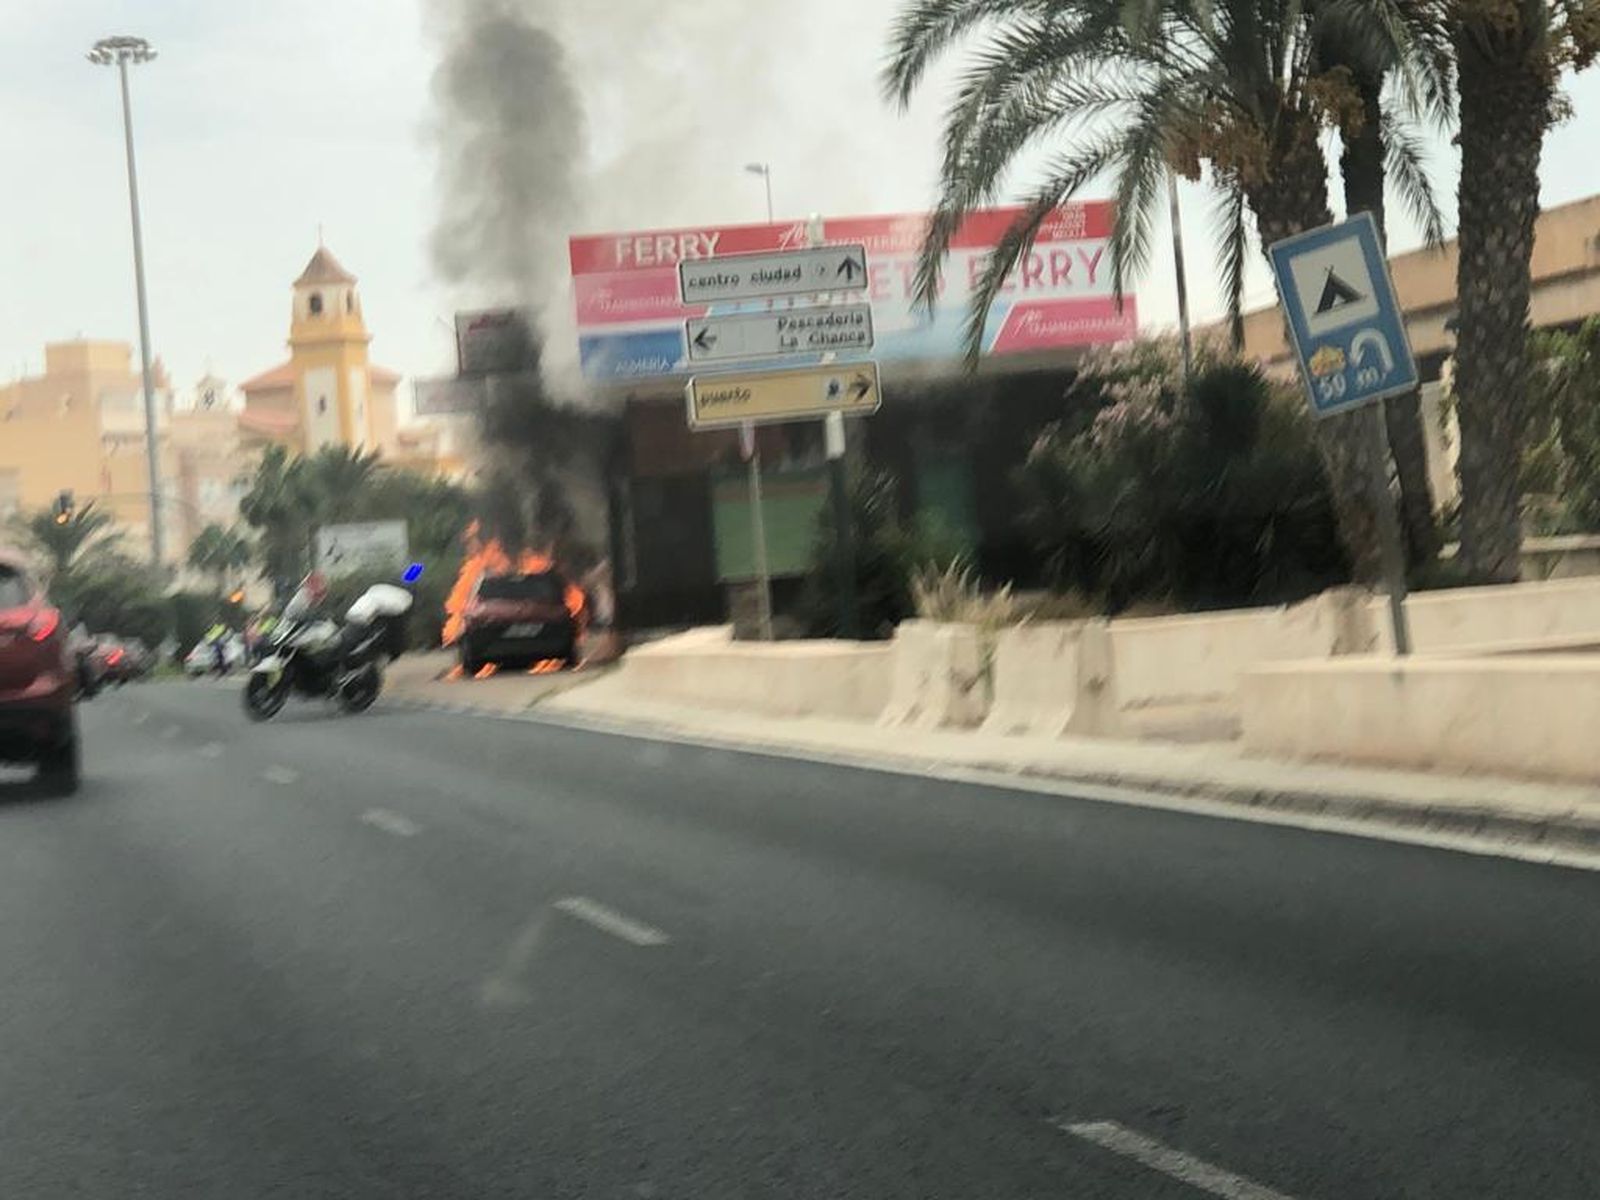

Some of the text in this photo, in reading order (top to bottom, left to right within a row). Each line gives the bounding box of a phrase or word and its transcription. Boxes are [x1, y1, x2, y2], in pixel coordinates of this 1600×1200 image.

[616, 231, 721, 268] FERRY
[688, 265, 802, 288] centro ciudad
[781, 328, 866, 347] La Chanca
[700, 386, 752, 408] puerto
